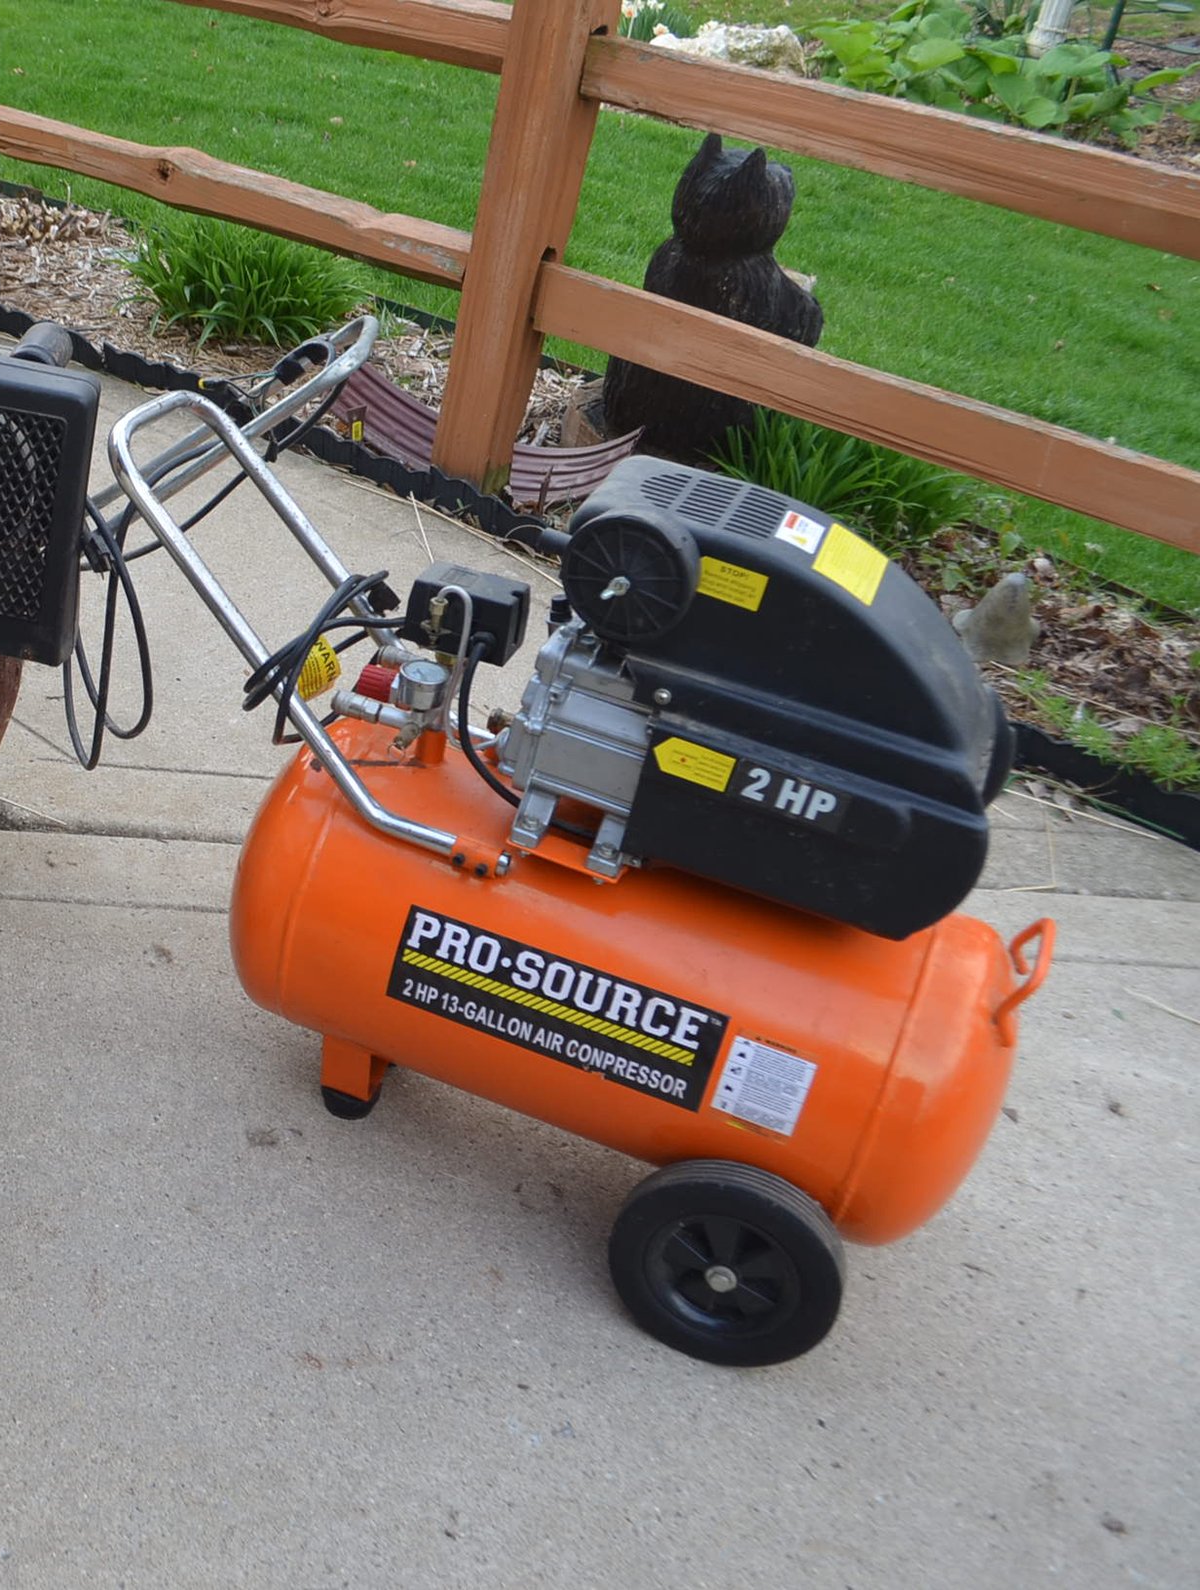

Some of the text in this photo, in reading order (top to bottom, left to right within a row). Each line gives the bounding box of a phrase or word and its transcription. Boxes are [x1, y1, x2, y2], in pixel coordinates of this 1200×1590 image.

[740, 767, 772, 802] 2
[774, 778, 838, 821] HP
[402, 978, 688, 1100] 2 HP 13-GALLON AIR CONPRESSOR
